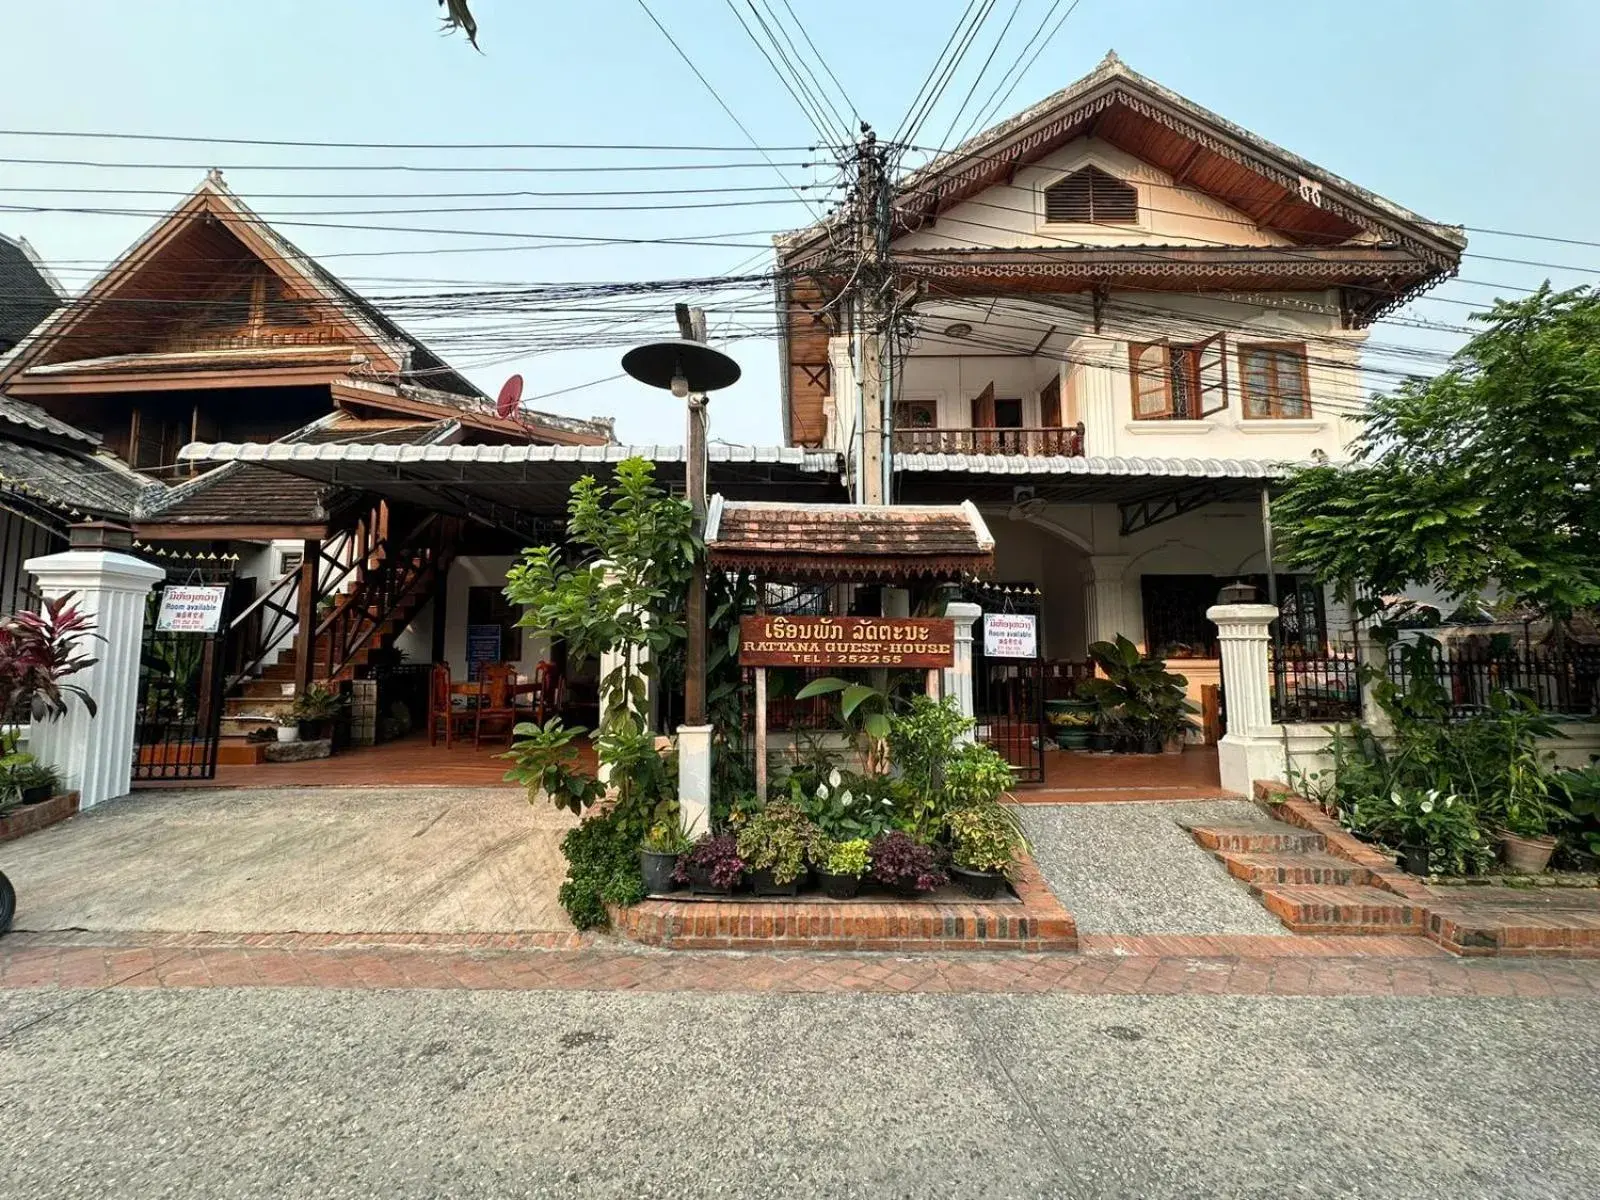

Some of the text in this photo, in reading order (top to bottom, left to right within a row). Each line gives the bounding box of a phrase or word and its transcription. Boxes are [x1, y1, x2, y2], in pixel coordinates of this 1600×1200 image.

[165, 602, 217, 610] Room available
[742, 641, 951, 654] RATTANA GUEST-HOUSE
[838, 655, 902, 664] 252255
